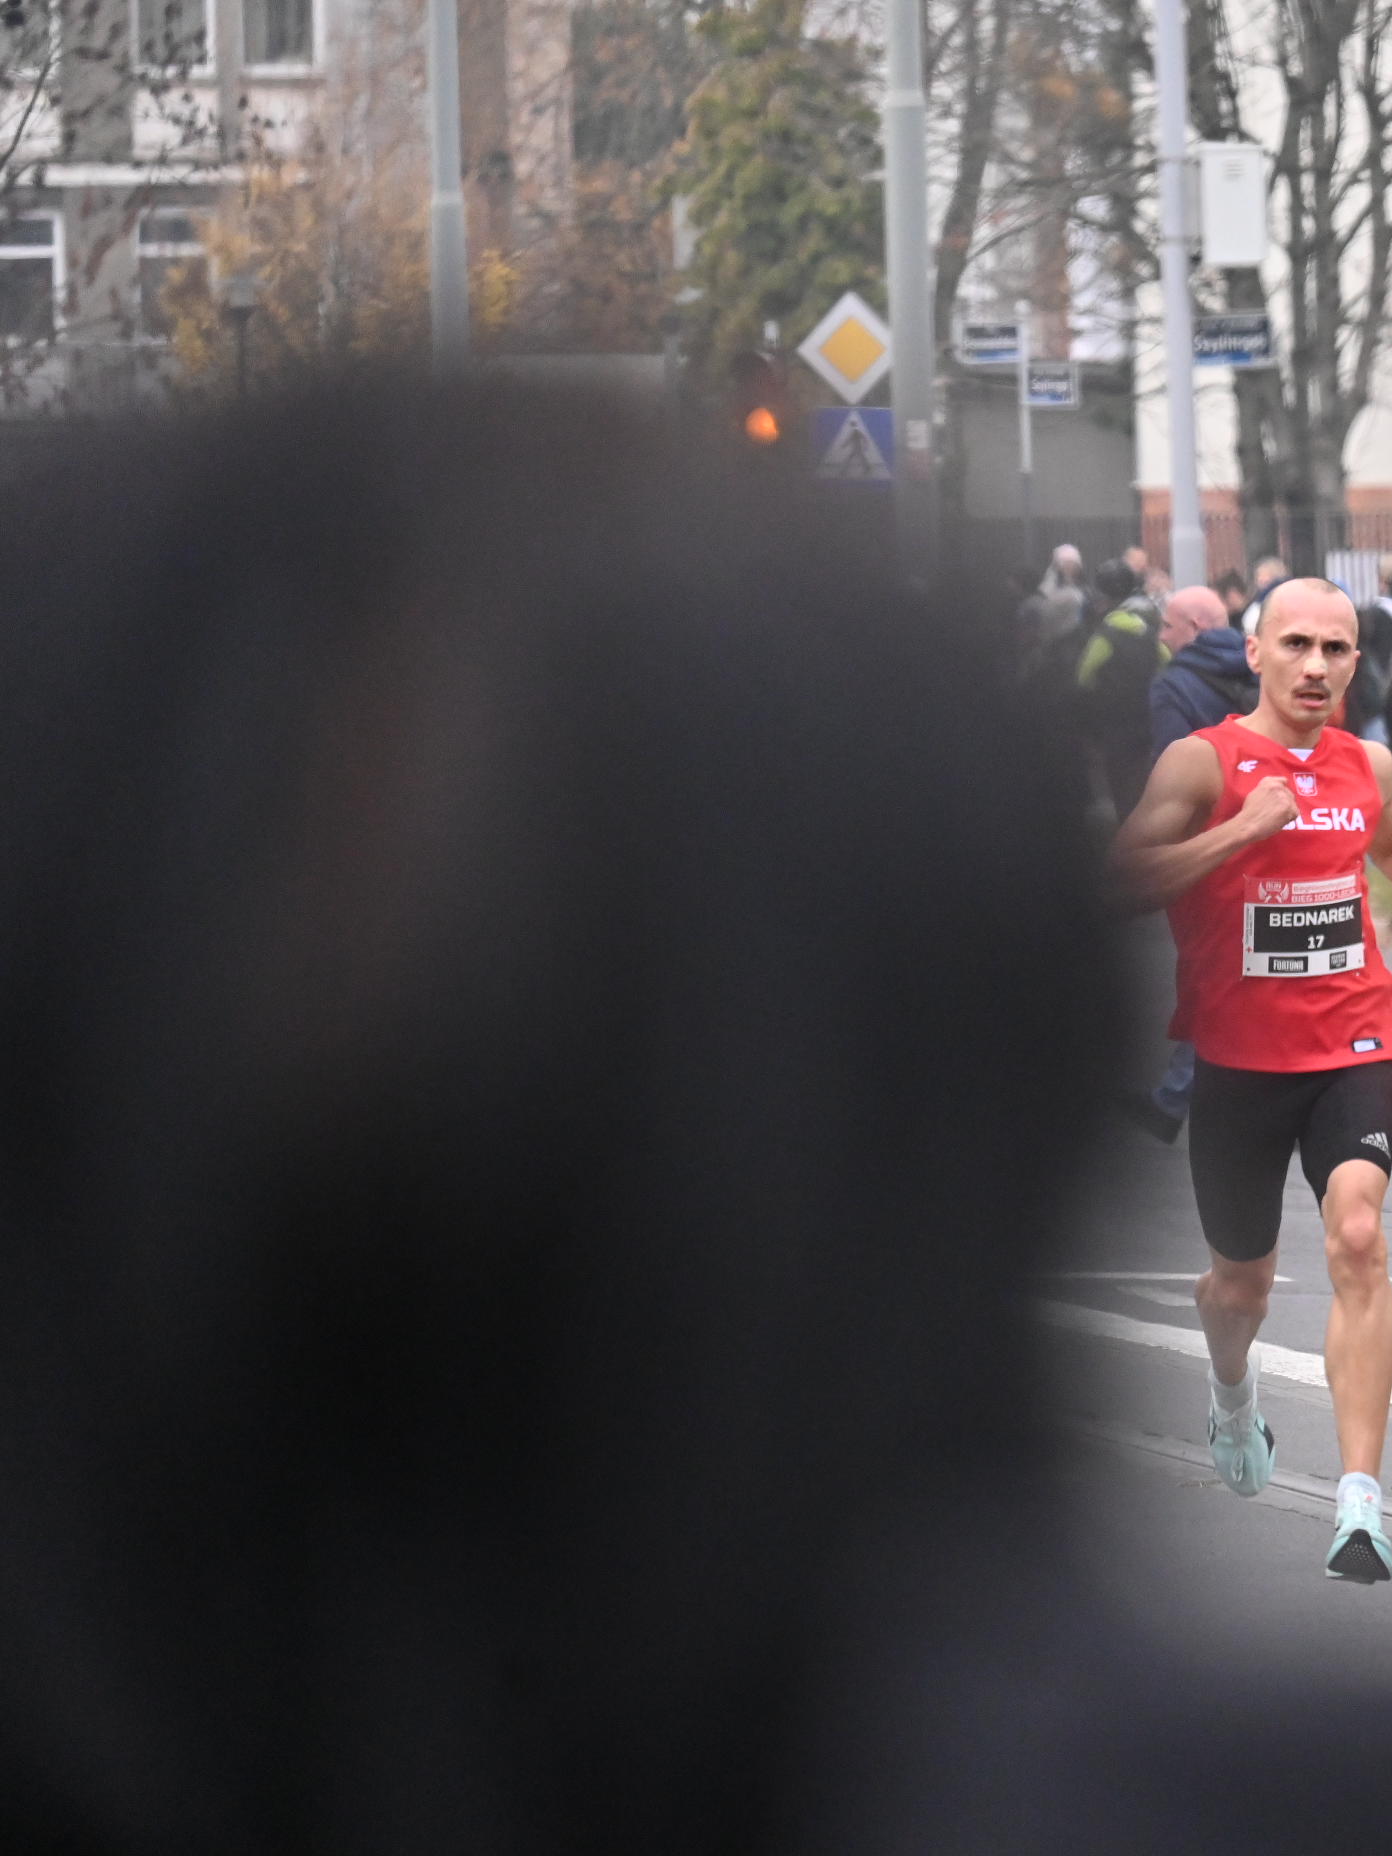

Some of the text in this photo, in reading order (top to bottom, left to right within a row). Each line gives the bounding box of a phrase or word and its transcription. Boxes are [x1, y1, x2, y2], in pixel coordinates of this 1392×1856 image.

[1282, 808, 1366, 832] LSKA
[1269, 904, 1355, 927] BEDNAREK
[1307, 935, 1325, 949] 17
[1273, 959, 1304, 971] FORTUNA
